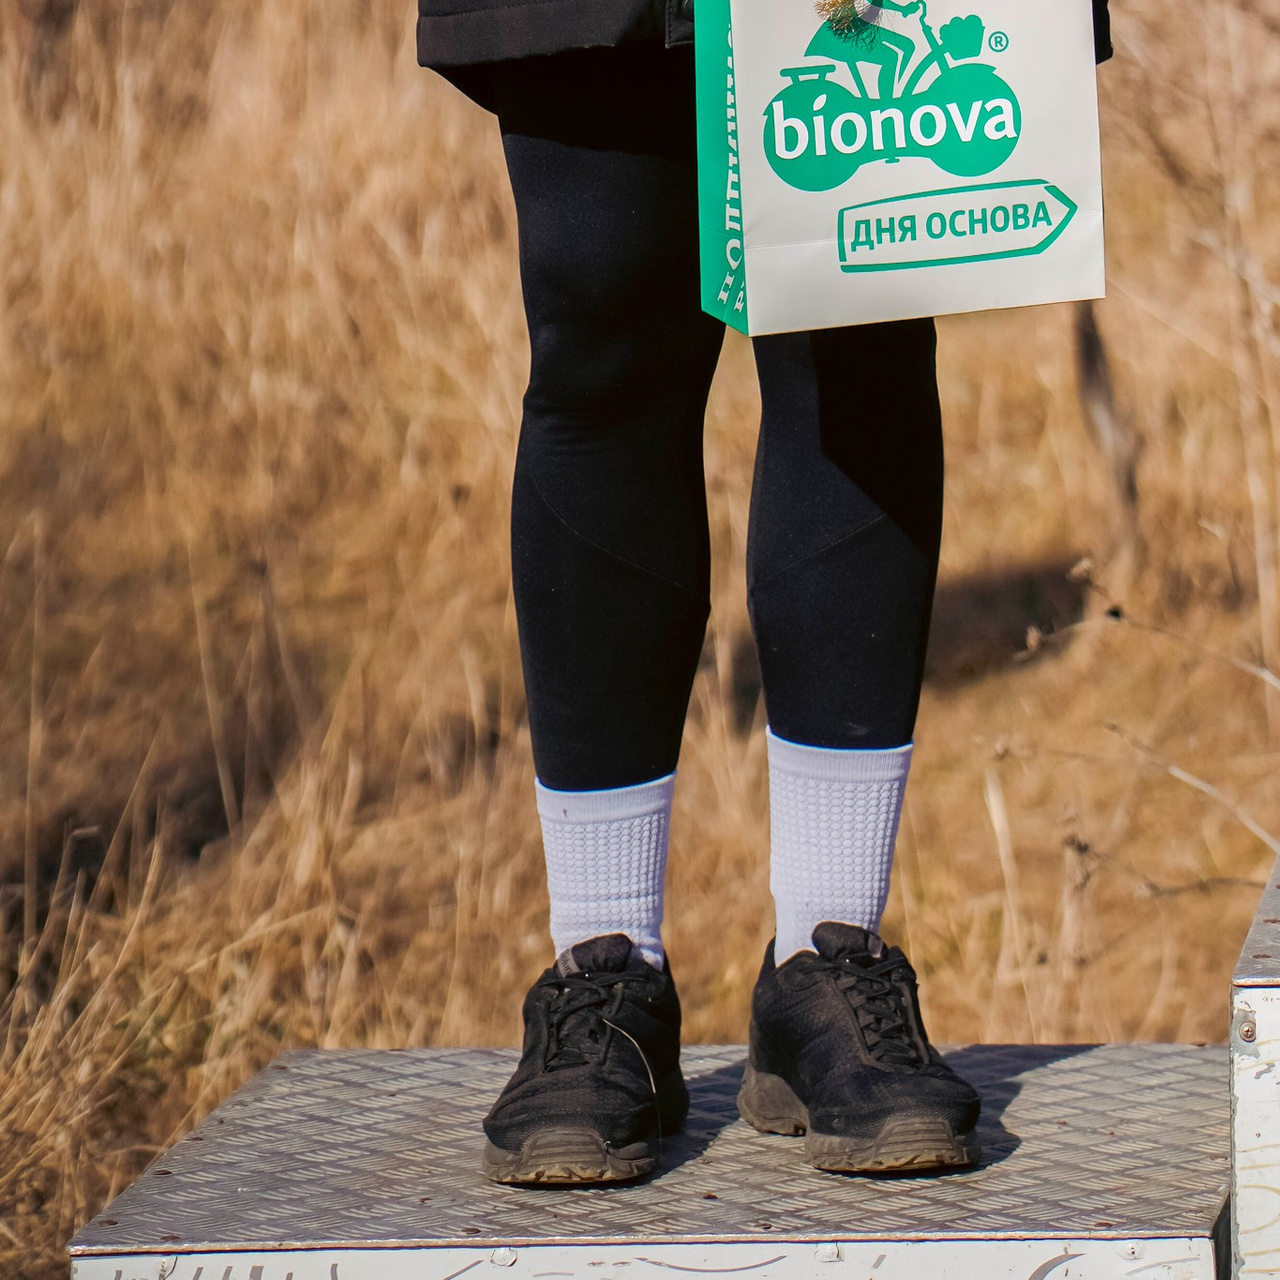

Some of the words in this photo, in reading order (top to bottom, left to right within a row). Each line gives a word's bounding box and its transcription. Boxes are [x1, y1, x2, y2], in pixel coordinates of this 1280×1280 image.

[771, 93, 1019, 160] bionova
[850, 214, 917, 253] ДНЯ
[925, 200, 1053, 240] ОСНОВА
